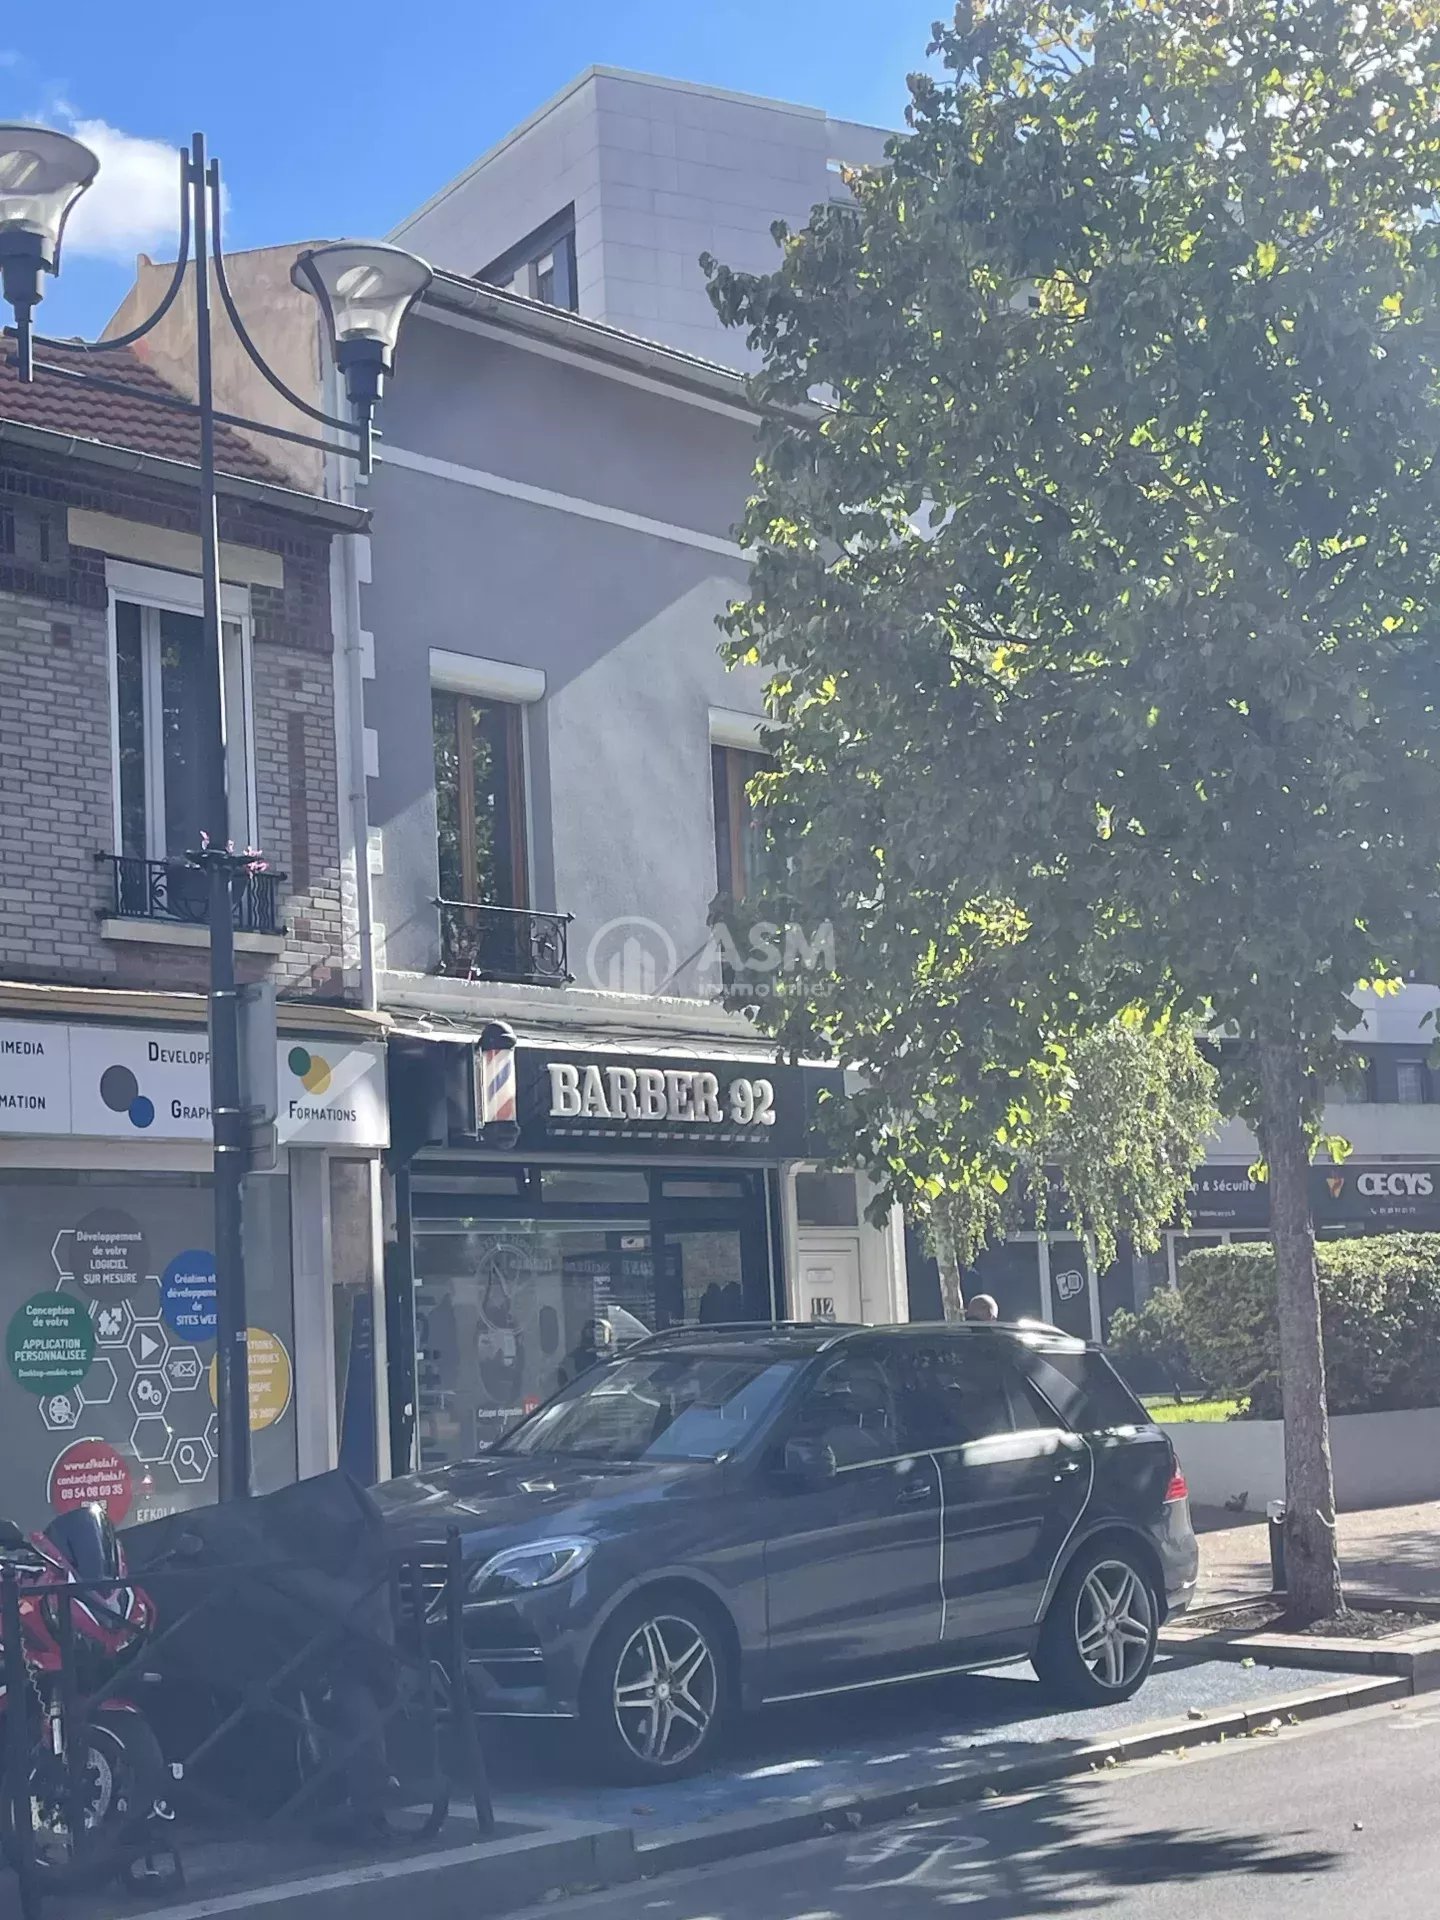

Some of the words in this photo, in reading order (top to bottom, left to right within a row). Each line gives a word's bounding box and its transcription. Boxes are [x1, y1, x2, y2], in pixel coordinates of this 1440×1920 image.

[1, 1041, 44, 1055] IMEDIA
[547, 1063, 723, 1123] BARBER
[729, 1078, 776, 1126] 92
[1357, 1173, 1433, 1195] CECYS
[77, 1231, 142, 1243] Développement
[92, 1245, 103, 1255] de
[105, 1245, 128, 1255] votre
[90, 1259, 128, 1270] LOGICIEL
[83, 1273, 101, 1284] SUR
[102, 1273, 138, 1284] MESURE
[26, 1305, 76, 1317] Conception
[192, 1301, 203, 1311] de
[810, 1297, 834, 1315] 112
[32, 1316, 44, 1327] de
[45, 1316, 69, 1327] votre
[176, 1314, 199, 1326] SITES
[22, 1338, 81, 1350] APPLICATION
[64, 1457, 118, 1471] www.efkola.fr
[57, 1470, 126, 1486] contact@efkola.fr
[61, 1489, 73, 1500] 09
[74, 1488, 86, 1498] 54
